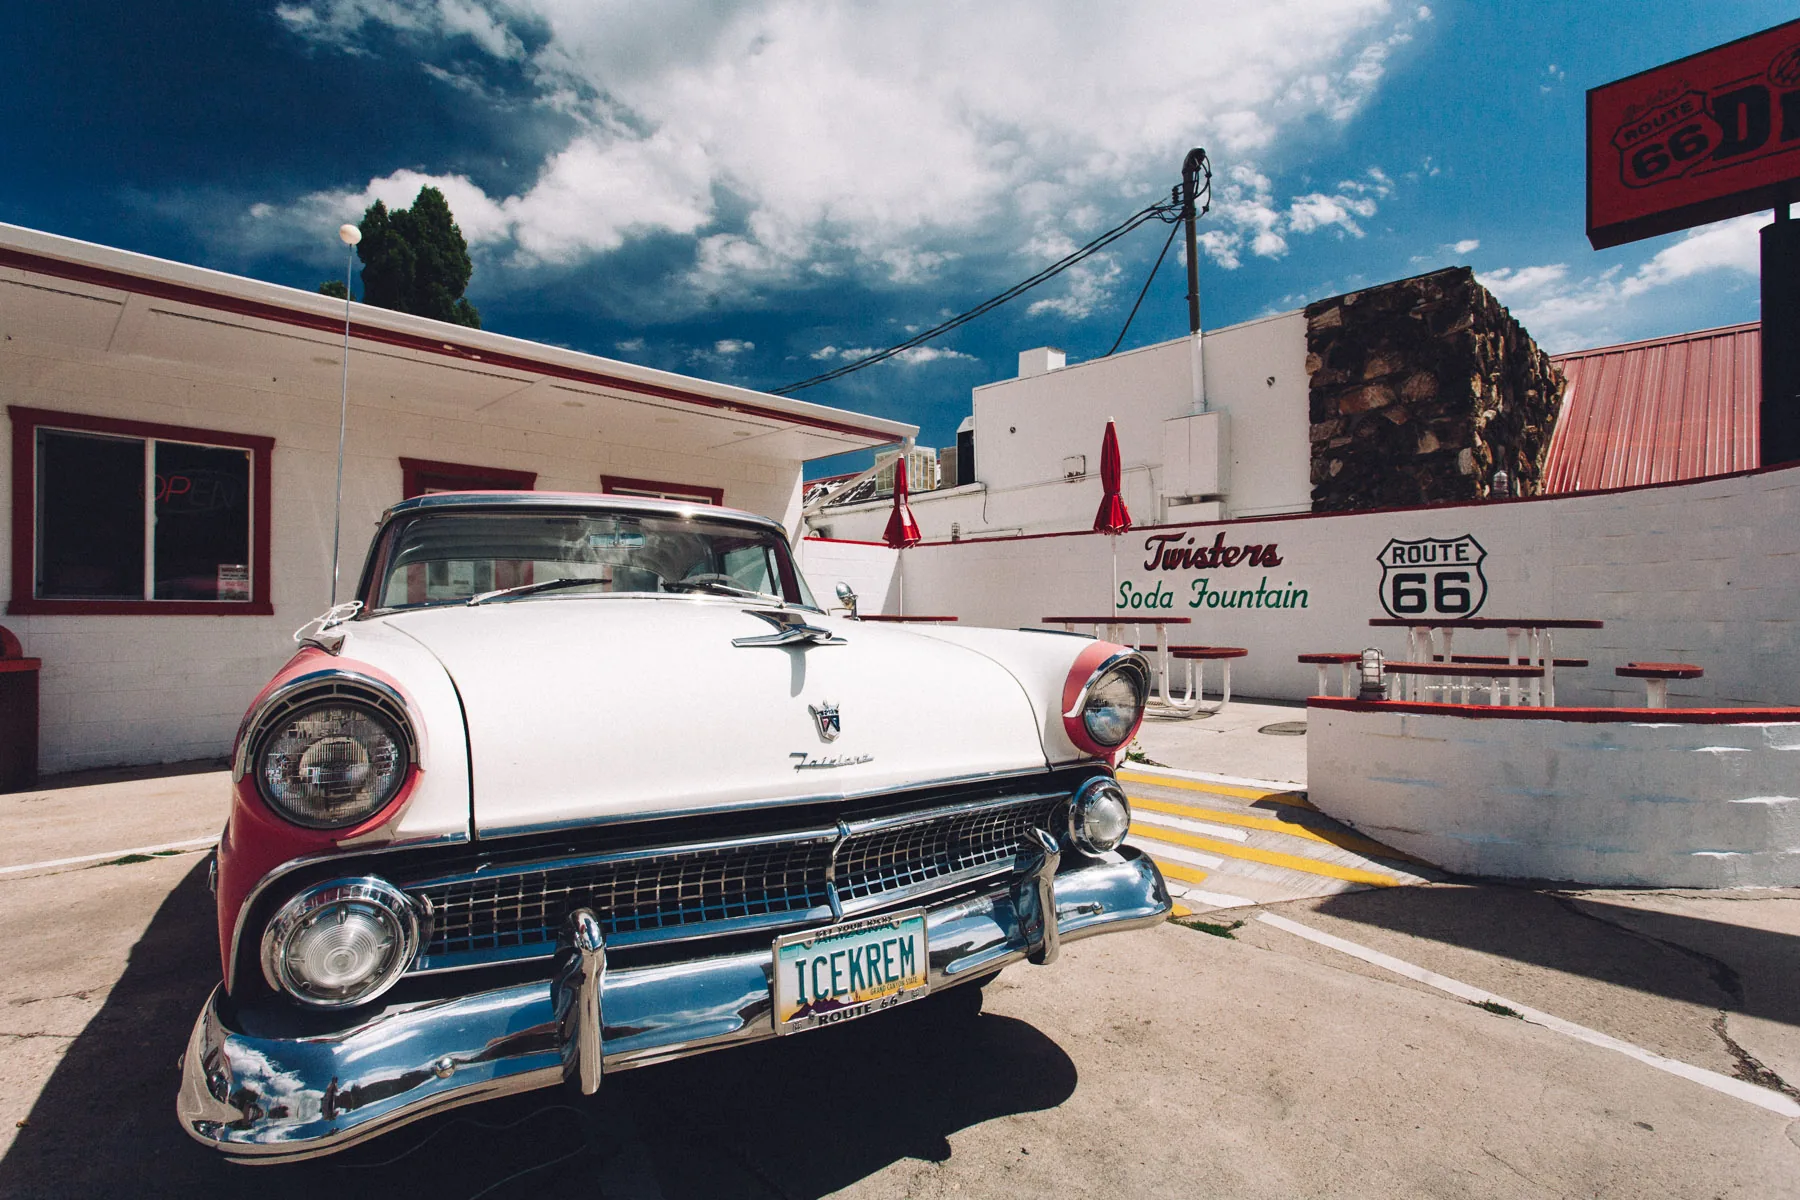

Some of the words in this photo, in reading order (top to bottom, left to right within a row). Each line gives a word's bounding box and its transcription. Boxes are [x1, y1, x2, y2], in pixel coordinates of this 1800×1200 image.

[1623, 100, 1694, 143] ROUTE
[1631, 123, 1709, 179] 66
[1144, 531, 1284, 571] Twisters
[1392, 543, 1470, 564] ROUTE
[1116, 580, 1174, 609] Soda
[1189, 576, 1309, 609] Fountain
[1392, 571, 1471, 614] 66
[815, 928, 832, 938] GET
[838, 921, 863, 933] YOUR
[867, 915, 893, 928] KICKS
[795, 934, 916, 1005] ICEKREM
[870, 985, 886, 995] GRAND
[887, 980, 904, 991] CANYON
[905, 976, 917, 986] STATE
[818, 1003, 872, 1025] ROUTE
[880, 996, 898, 1010] 66
